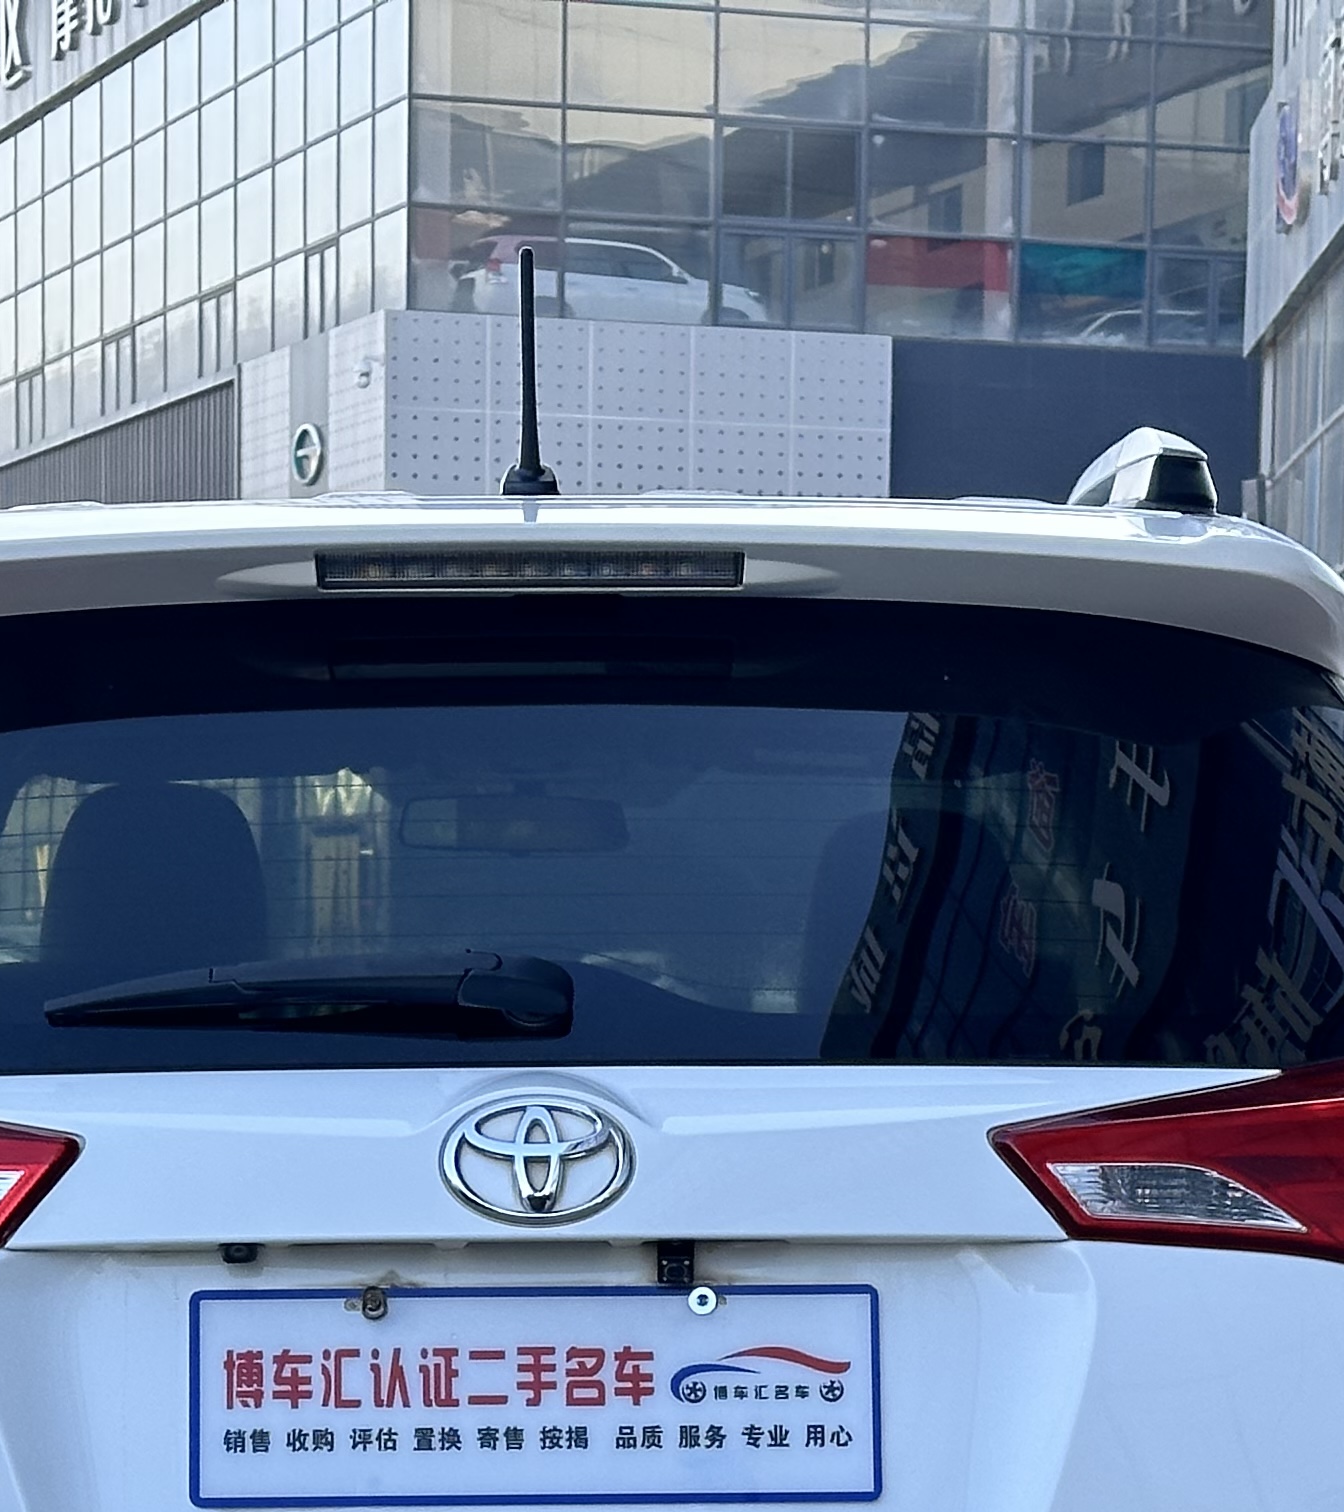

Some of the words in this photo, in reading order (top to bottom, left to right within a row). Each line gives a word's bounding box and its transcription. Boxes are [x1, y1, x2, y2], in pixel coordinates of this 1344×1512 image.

[223, 1346, 655, 1409] 博车汇认证二手名车
[223, 1428, 271, 1453] 销售
[286, 1428, 335, 1452] 收购
[349, 1427, 398, 1451] 评估
[413, 1427, 462, 1451] 置换
[476, 1425, 525, 1450] 寄售
[539, 1425, 588, 1450] 按揭
[615, 1425, 664, 1450] 品质
[678, 1424, 727, 1449] 服务
[741, 1424, 790, 1449] 专业
[805, 1424, 854, 1448] 用心
